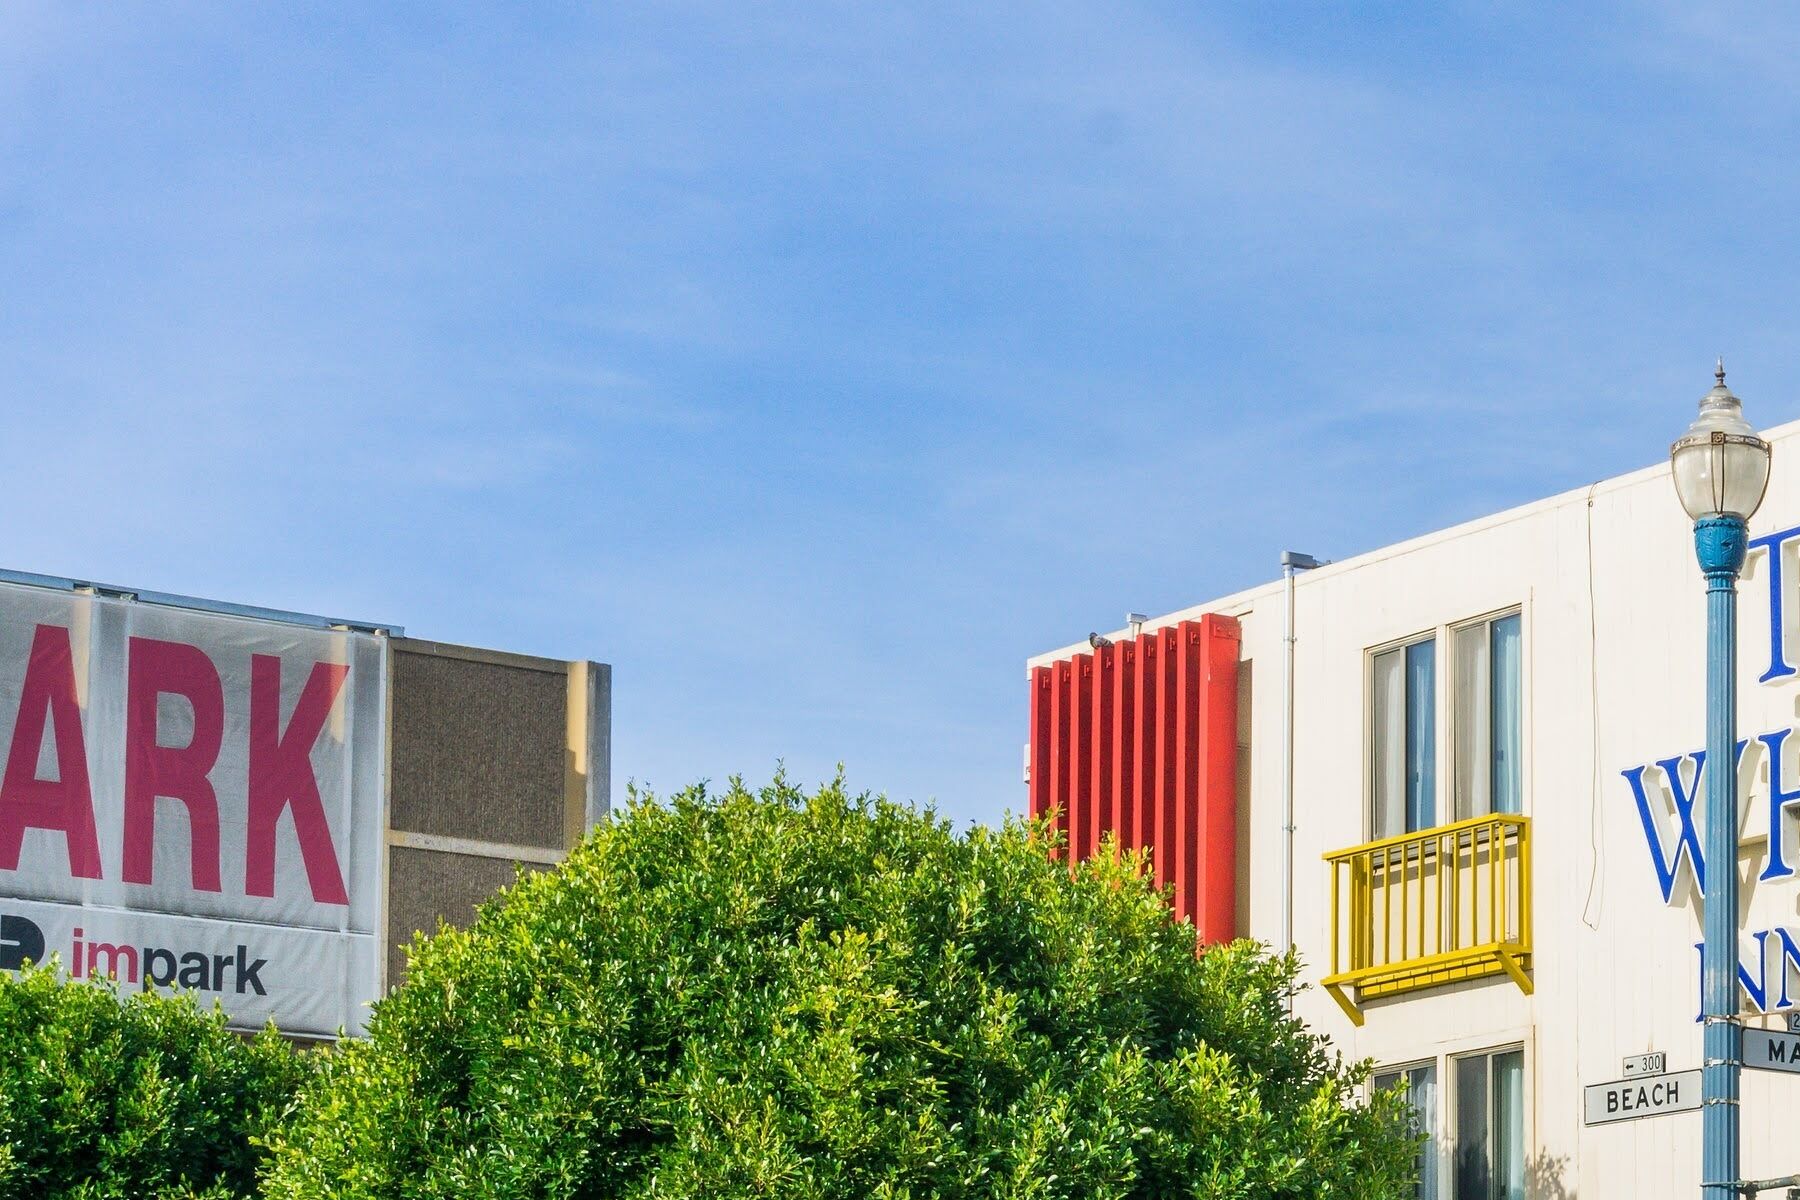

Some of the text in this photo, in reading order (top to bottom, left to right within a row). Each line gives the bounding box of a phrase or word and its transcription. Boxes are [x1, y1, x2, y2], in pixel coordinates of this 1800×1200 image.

[72, 927, 268, 996] impark
[1641, 1055, 1661, 1072] 300
[1606, 1081, 1679, 1113] BEACH
